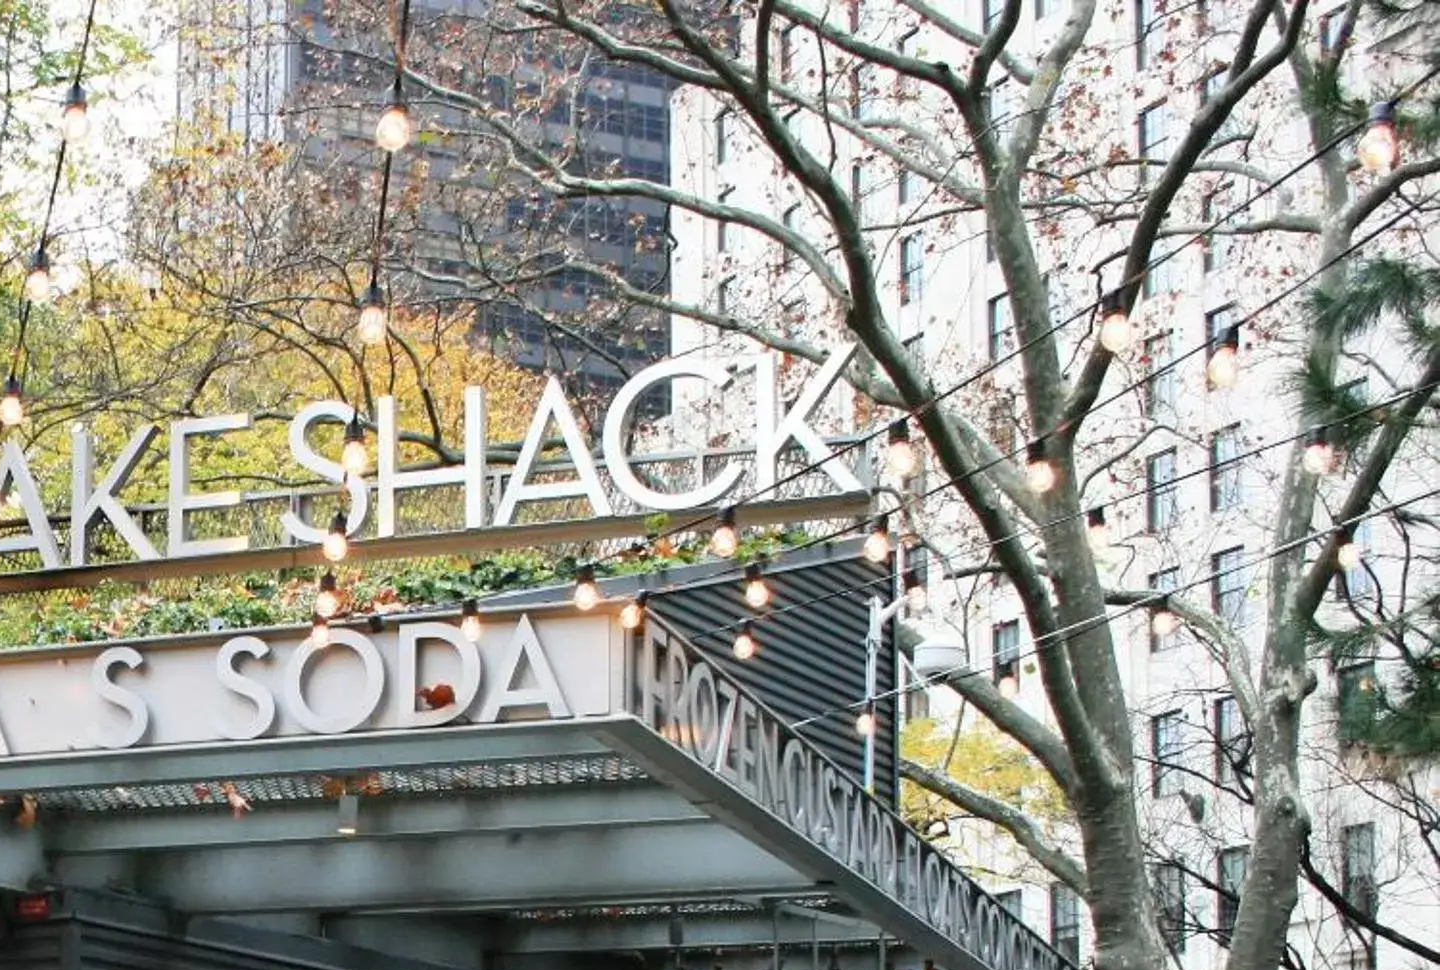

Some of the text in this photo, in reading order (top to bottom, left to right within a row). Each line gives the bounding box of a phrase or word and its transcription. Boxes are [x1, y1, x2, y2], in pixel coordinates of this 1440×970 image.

[278, 343, 860, 541] SHACK
[216, 612, 574, 741] SODA
[644, 616, 779, 818] FROZEN
[782, 738, 897, 900] CUSTARD
[905, 830, 971, 953] FLOATS
